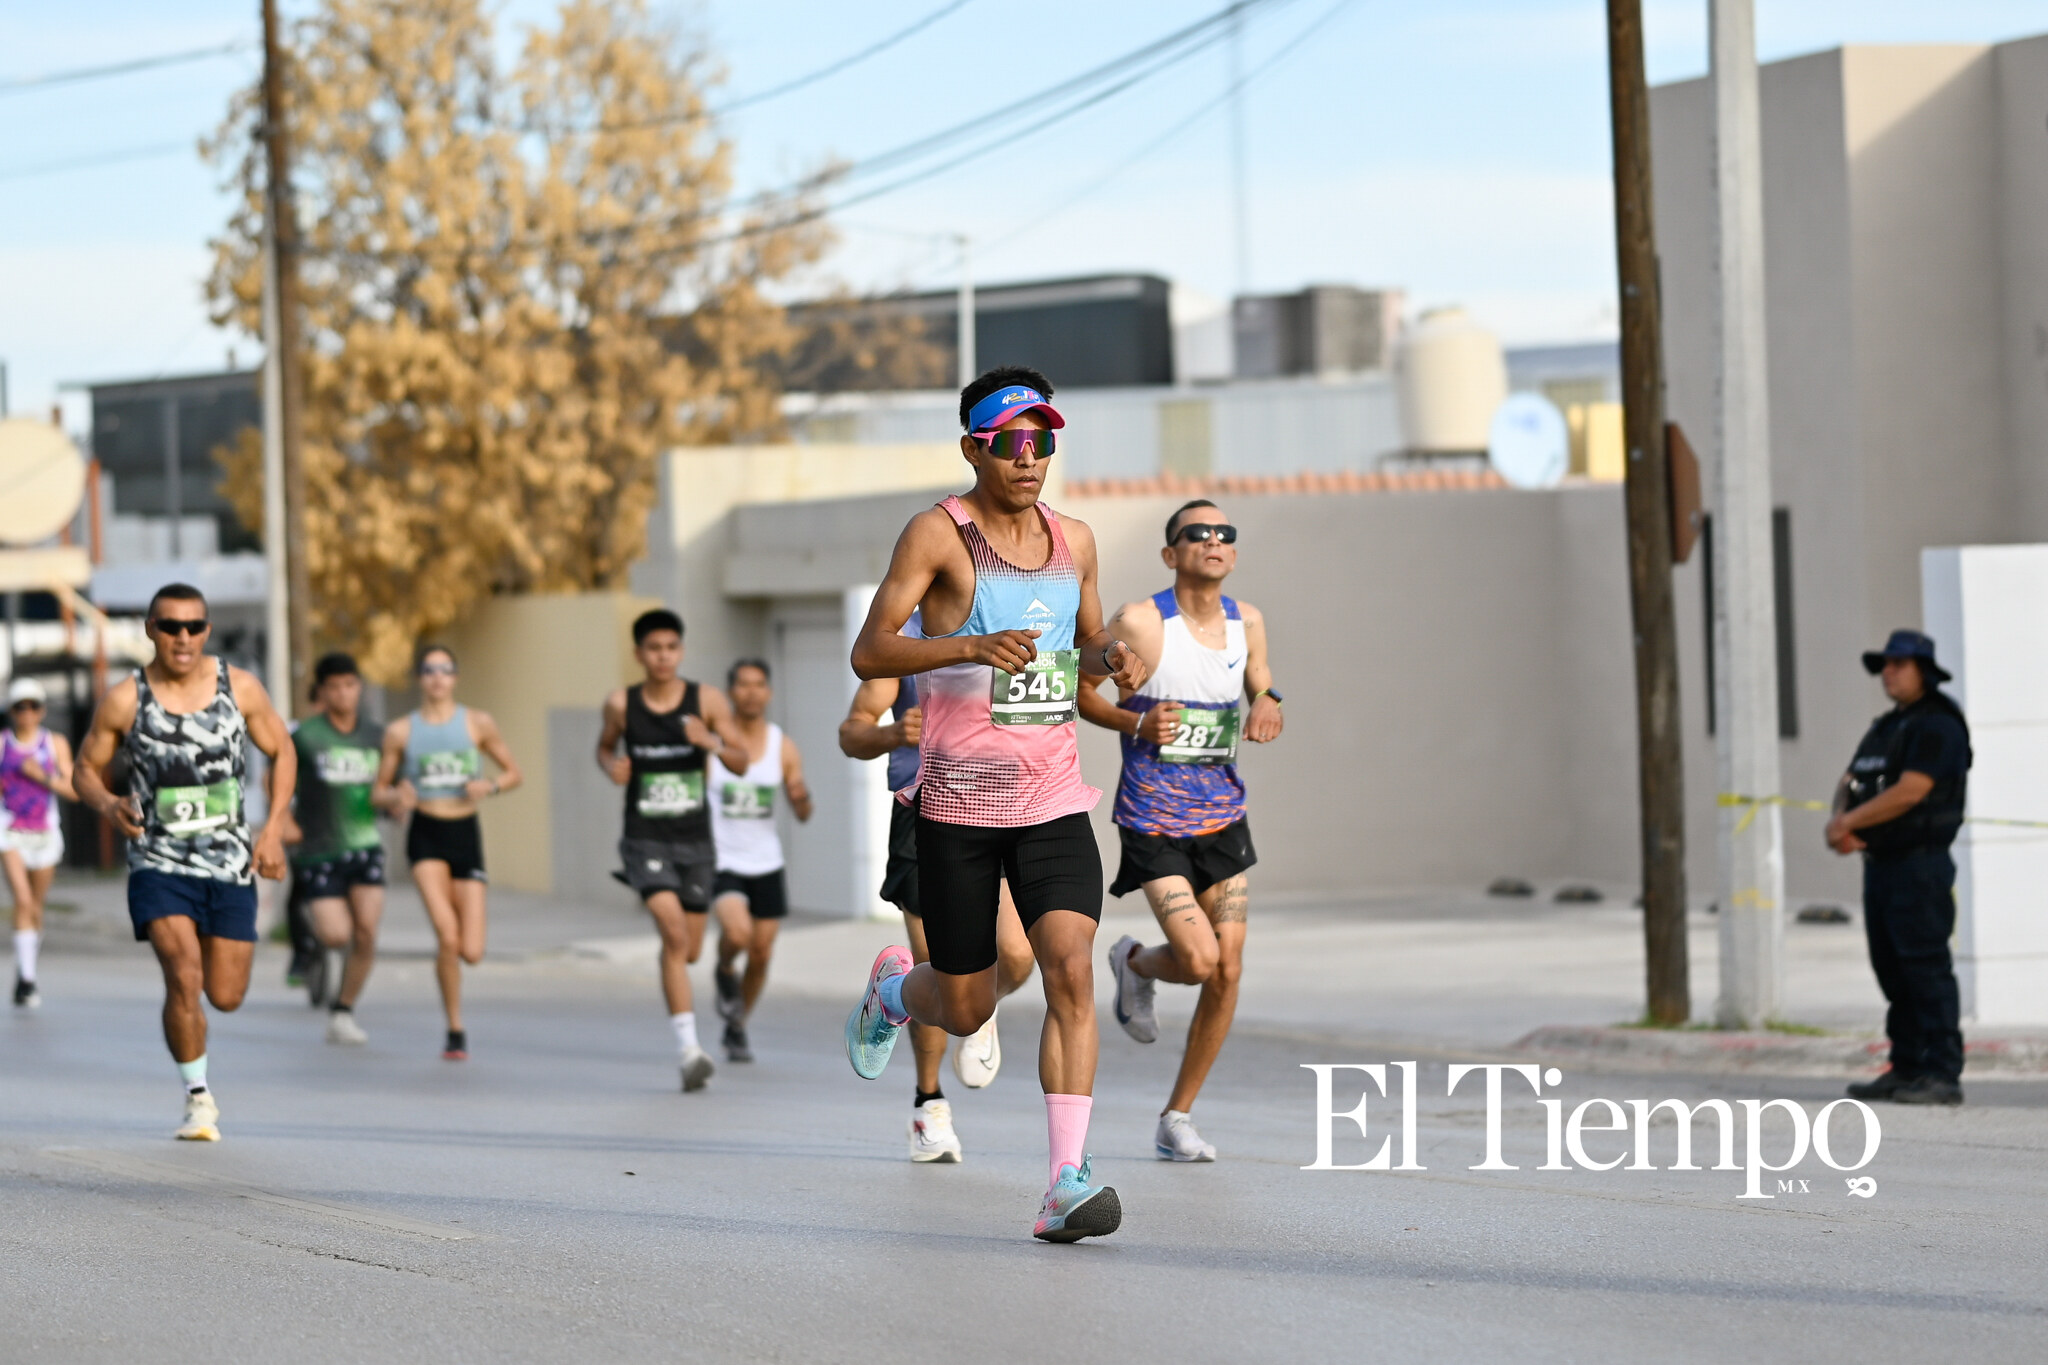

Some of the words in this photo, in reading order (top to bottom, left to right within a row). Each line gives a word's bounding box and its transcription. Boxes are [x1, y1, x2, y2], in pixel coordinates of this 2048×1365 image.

[1007, 671, 1066, 702] 545
[1172, 724, 1224, 748] 287
[175, 801, 206, 822] 91
